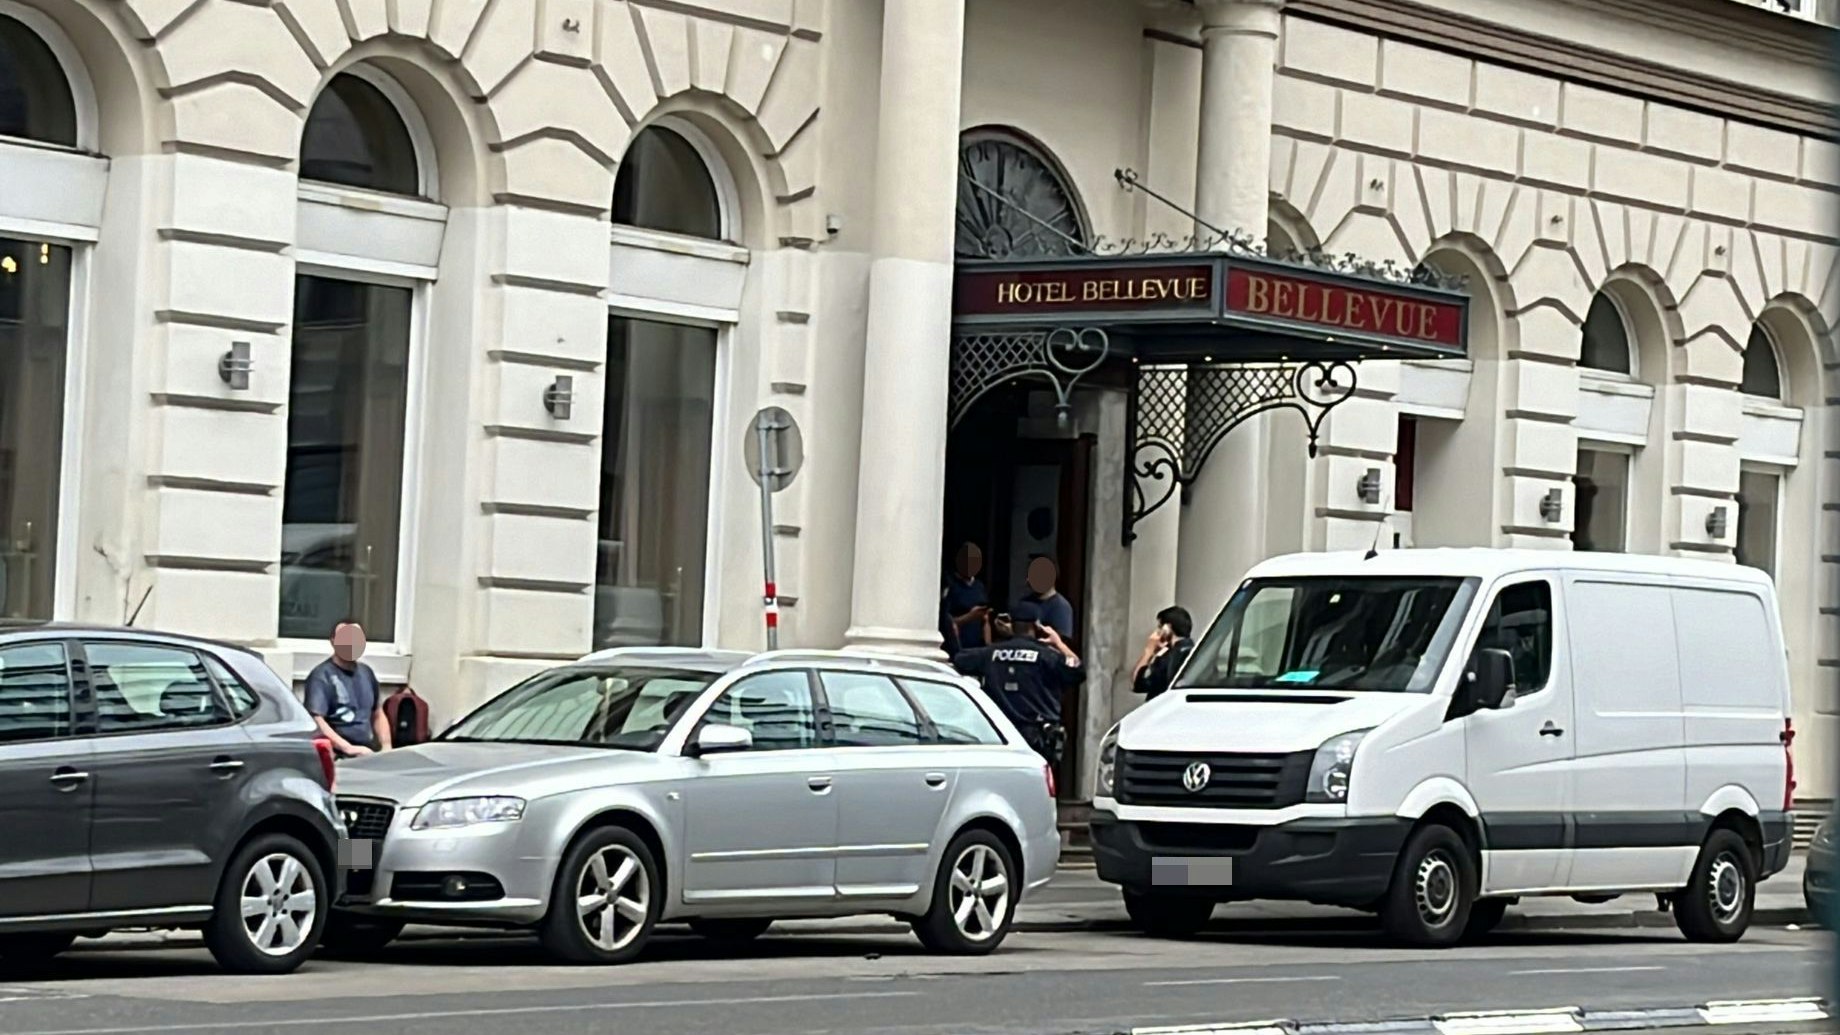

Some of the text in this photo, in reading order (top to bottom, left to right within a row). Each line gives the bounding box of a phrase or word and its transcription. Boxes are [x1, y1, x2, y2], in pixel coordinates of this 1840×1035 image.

[998, 278, 1207, 303] HOTEL BELLEVUE
[1246, 275, 1438, 340] BELLEVUE
[992, 649, 1039, 663] POLIZEI
